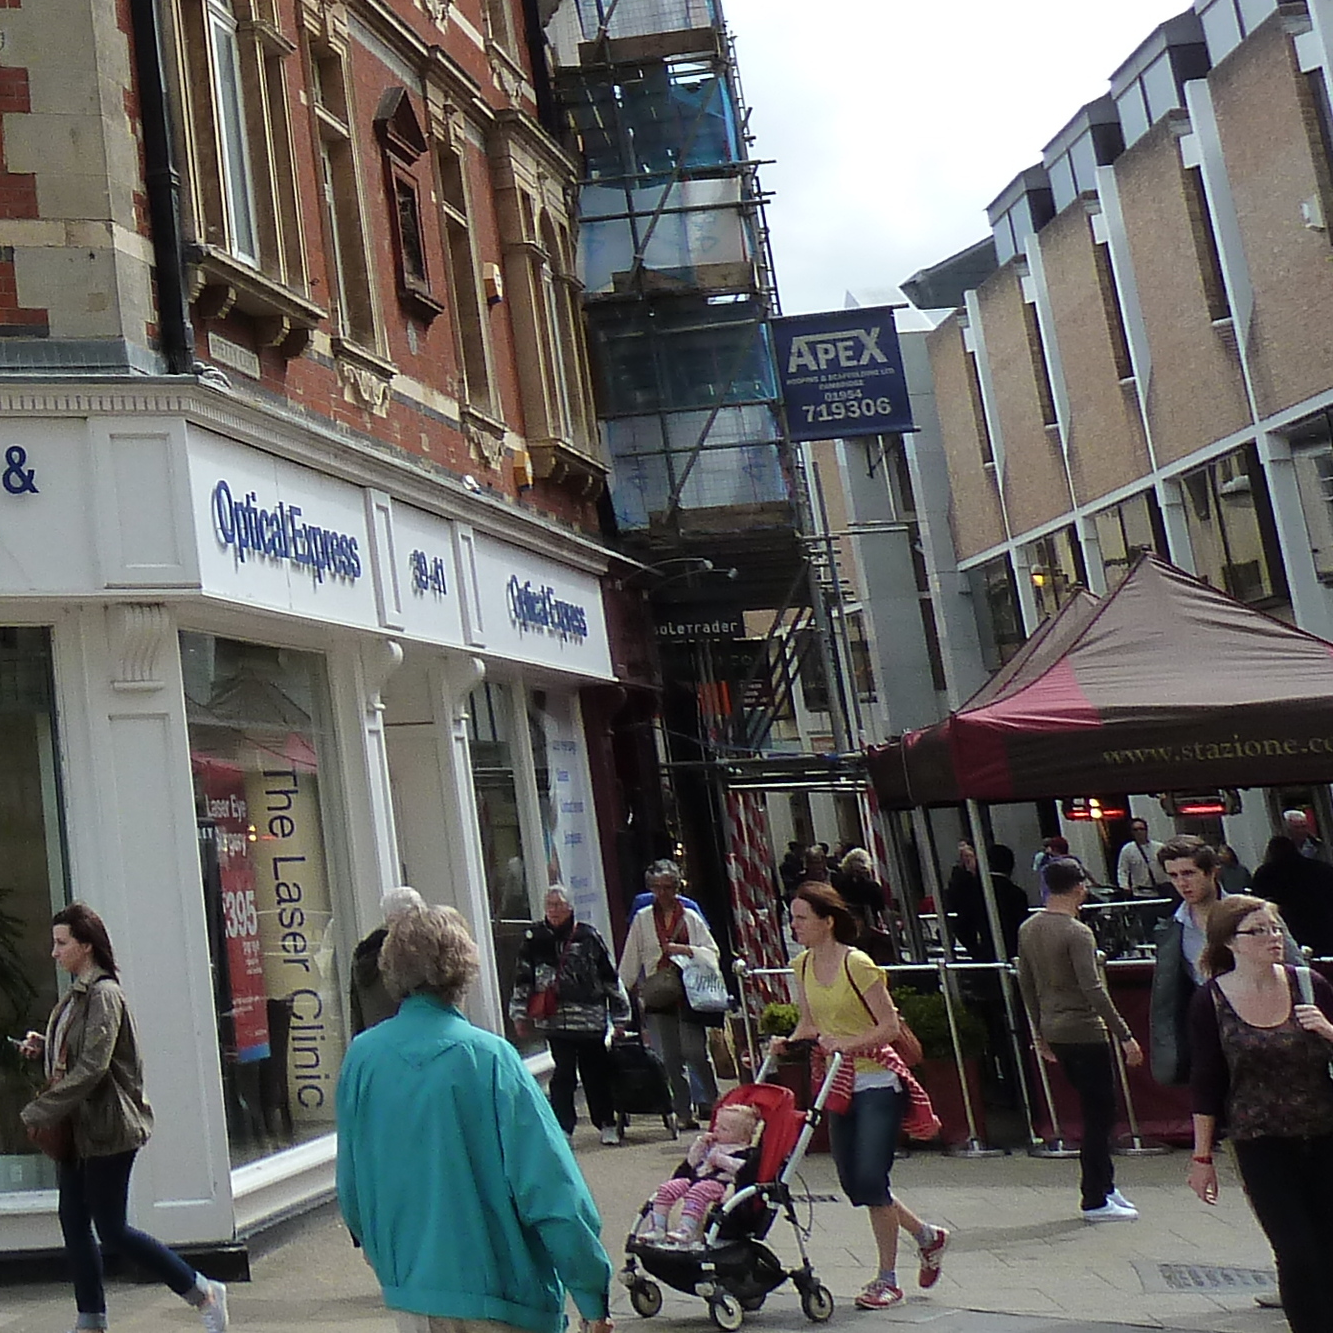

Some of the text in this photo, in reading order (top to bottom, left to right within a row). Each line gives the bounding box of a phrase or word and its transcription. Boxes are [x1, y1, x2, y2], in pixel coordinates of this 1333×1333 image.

[787, 327, 889, 374] APEX
[802, 397, 892, 423] 719306
[824, 389, 863, 402] 01954
[1, 445, 40, 495] &
[213, 480, 362, 584] Optical Express
[509, 574, 588, 643] Optical Express
[204, 794, 247, 823] Laser Eye
[263, 769, 330, 1109] The Laser Clinic
